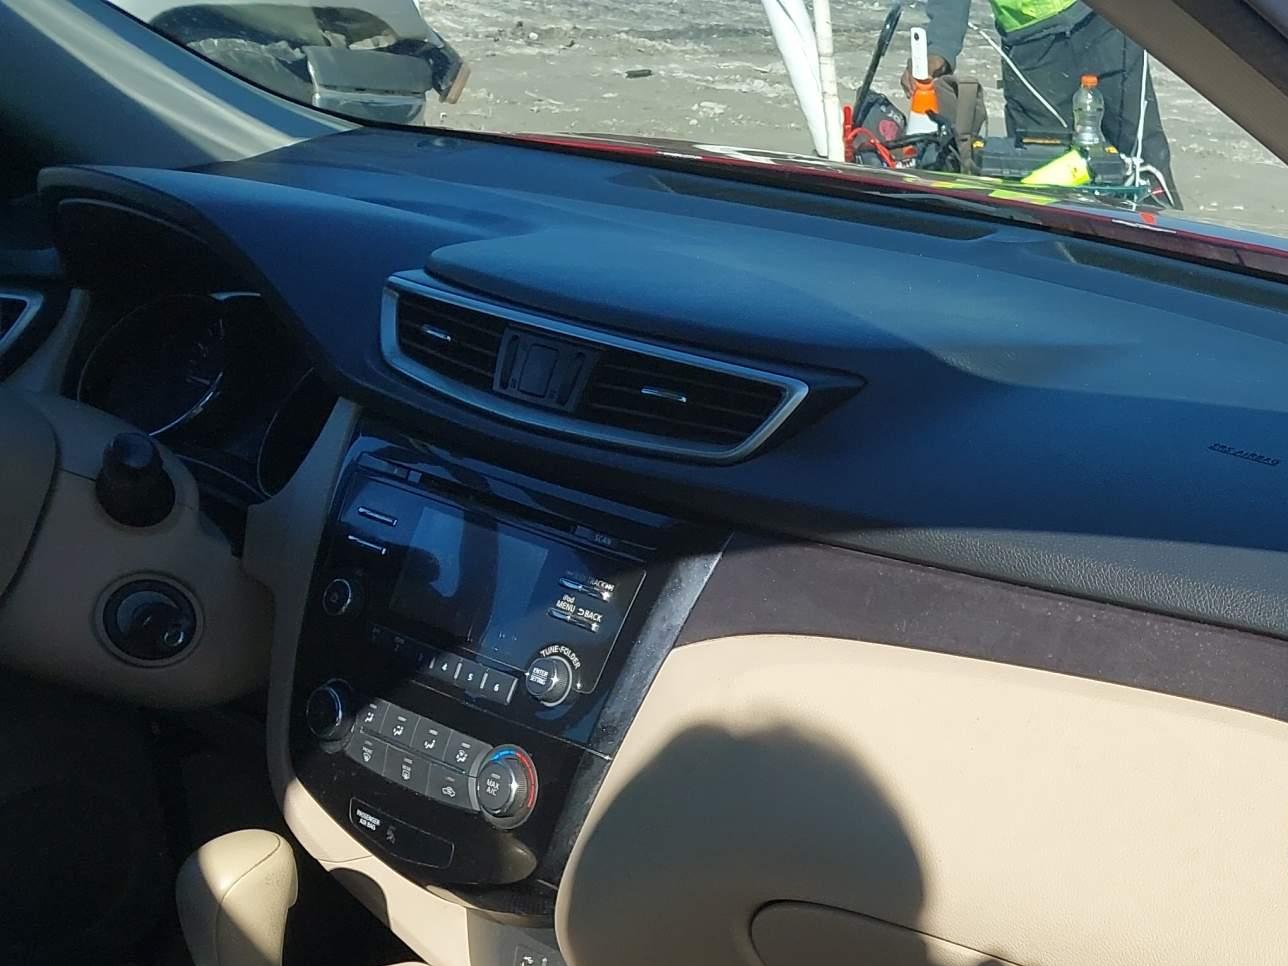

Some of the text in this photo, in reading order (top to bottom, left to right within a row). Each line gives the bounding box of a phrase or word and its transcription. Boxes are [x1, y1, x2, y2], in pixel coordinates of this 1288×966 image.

[562, 594, 575, 604] iPod
[556, 600, 603, 623] MENU BACK
[441, 663, 448, 671] 4
[467, 673, 474, 681] 5
[493, 683, 500, 692] 6
[486, 778, 500, 790] MAX
[486, 786, 497, 797] A/C
